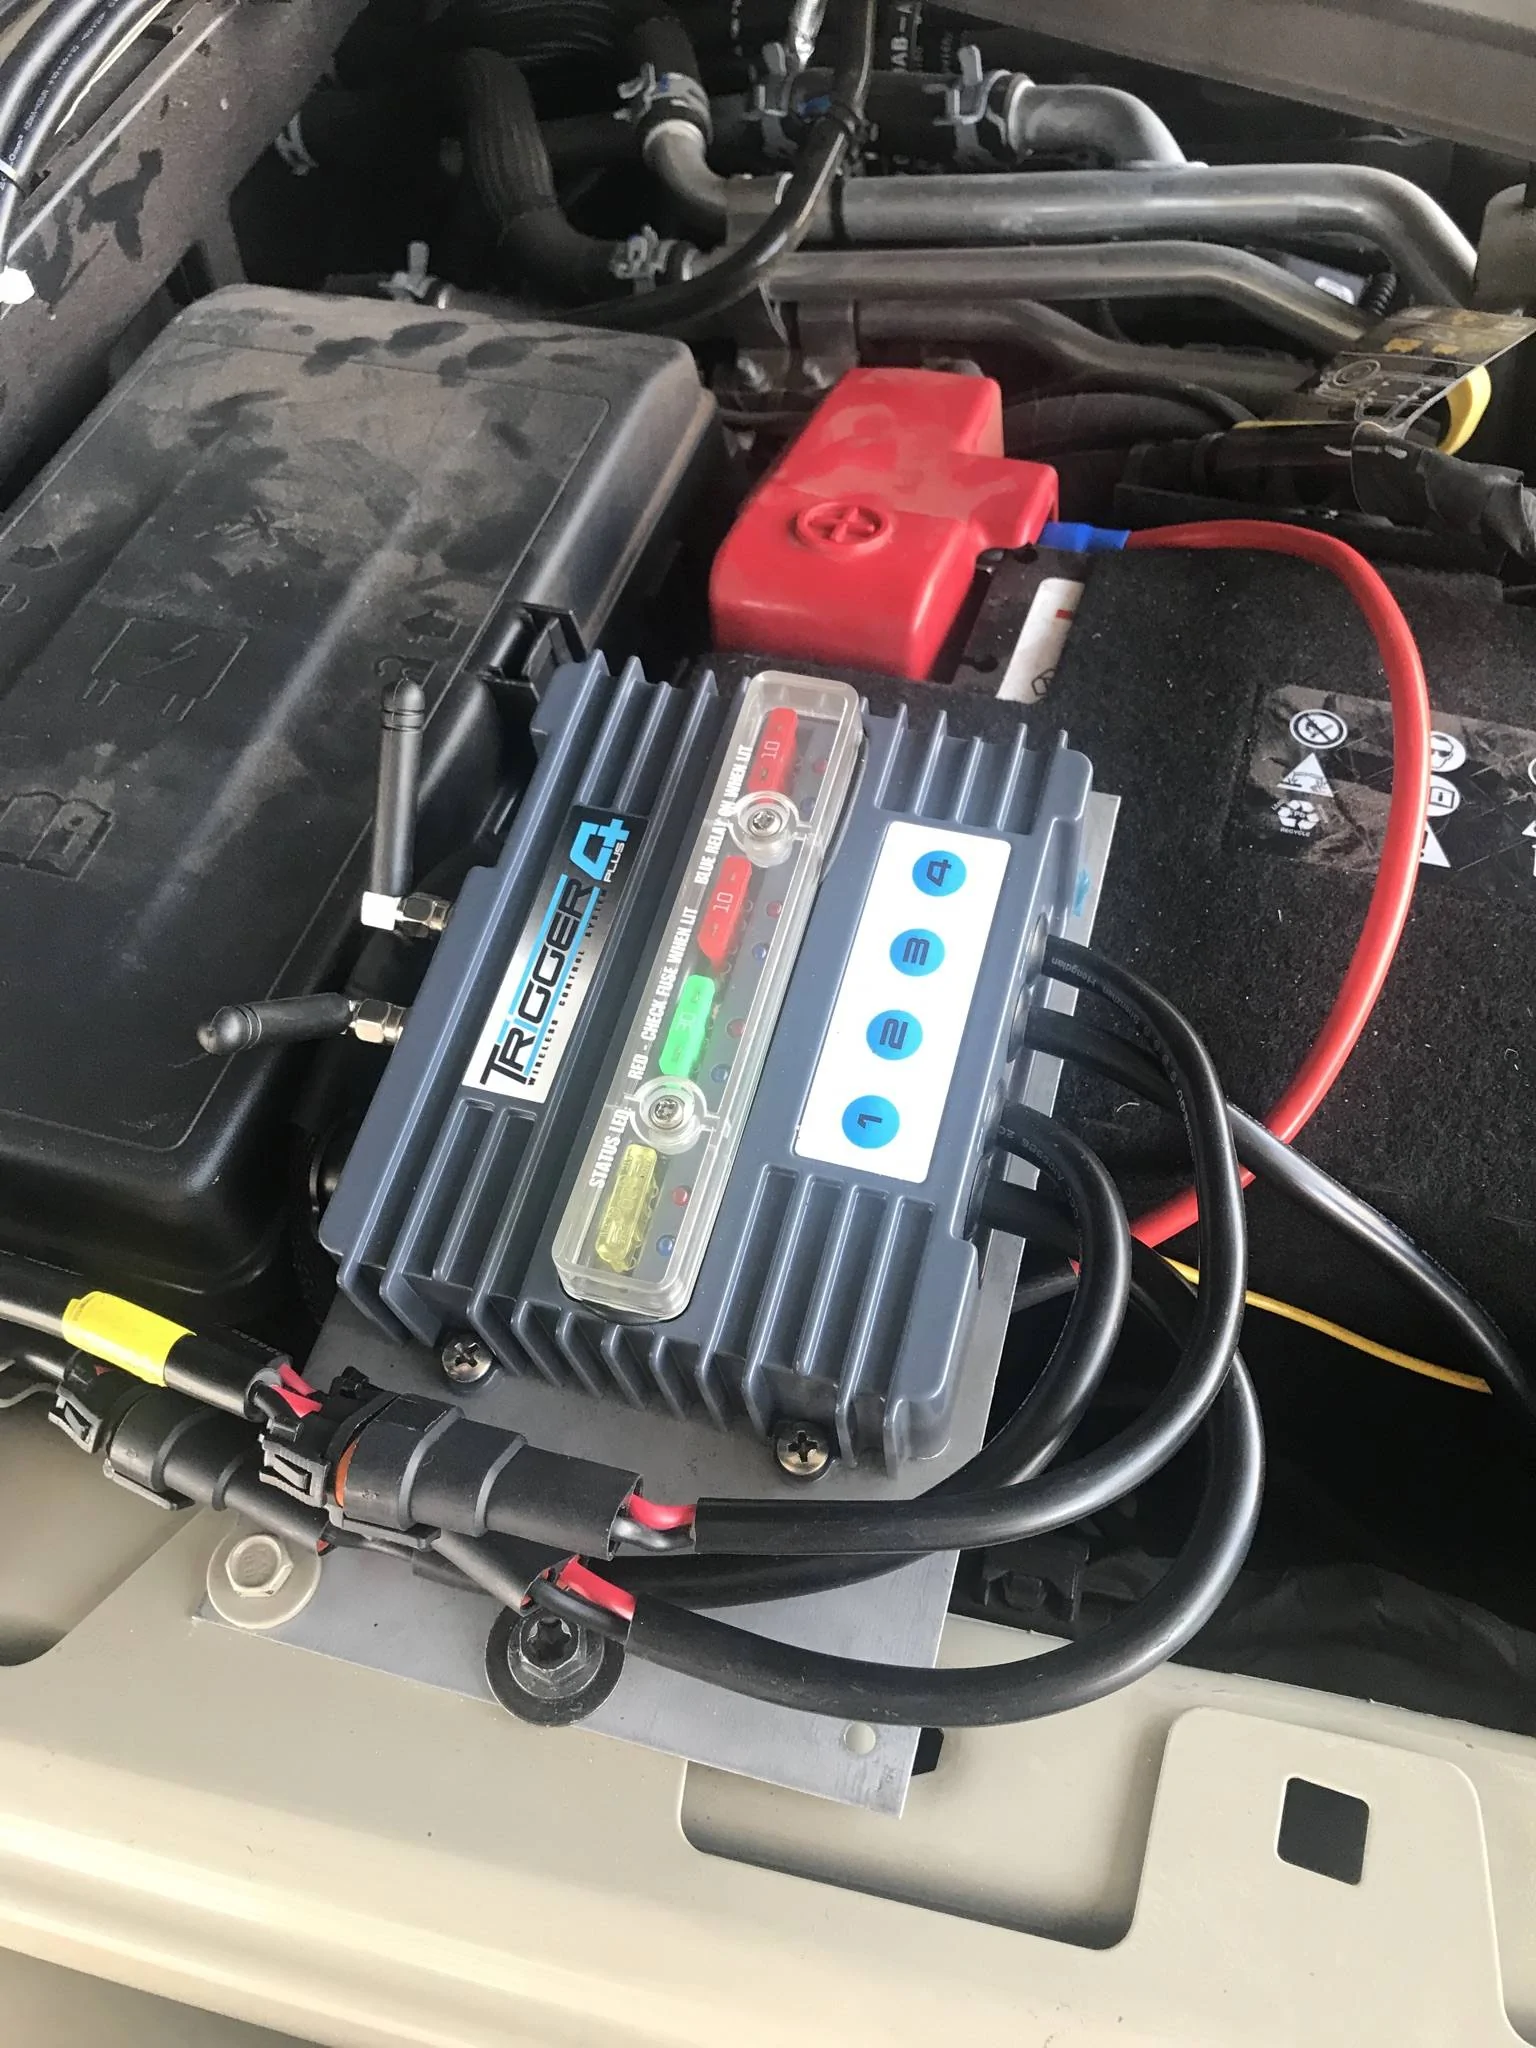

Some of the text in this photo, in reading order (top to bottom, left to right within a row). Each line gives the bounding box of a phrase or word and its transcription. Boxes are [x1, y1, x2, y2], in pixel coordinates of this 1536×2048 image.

[736, 744, 753, 764] LIT
[761, 740, 780, 760] 10
[724, 763, 746, 799] WHEN
[718, 800, 737, 817] ON
[704, 817, 729, 853] RELAY
[603, 841, 625, 883] PLUS
[694, 855, 716, 885] BLUE
[926, 858, 952, 887] 4
[680, 906, 698, 927] LIT
[712, 891, 734, 913] 10
[667, 925, 692, 966] WHEN
[902, 937, 930, 966] 3
[528, 889, 608, 1085] WIRELESS CONTROL SYSTEM
[656, 964, 679, 998] FUSE
[640, 995, 666, 1041] CHECK
[879, 1018, 909, 1050] 2
[628, 1053, 648, 1080] RED
[857, 1113, 883, 1129] 1
[589, 1134, 621, 1189] STATUS
